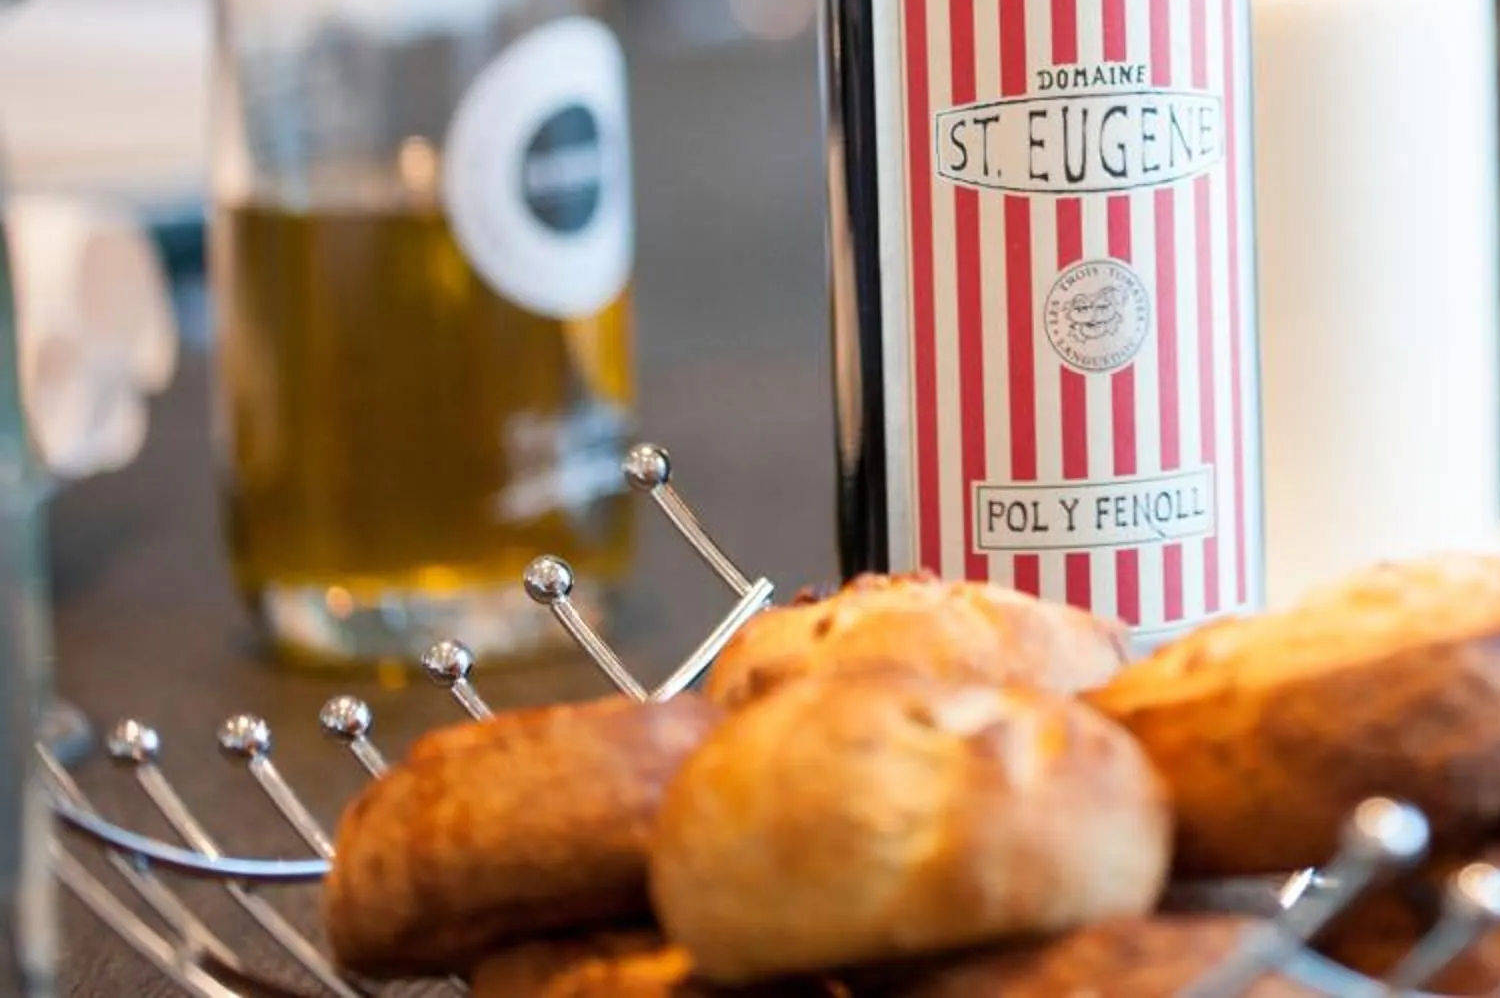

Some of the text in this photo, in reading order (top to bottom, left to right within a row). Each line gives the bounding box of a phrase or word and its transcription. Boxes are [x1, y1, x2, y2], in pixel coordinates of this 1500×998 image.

[1037, 64, 1147, 91] DOMAINE
[950, 113, 1003, 178] ST.
[987, 486, 1206, 537] POL Y FENOLL
